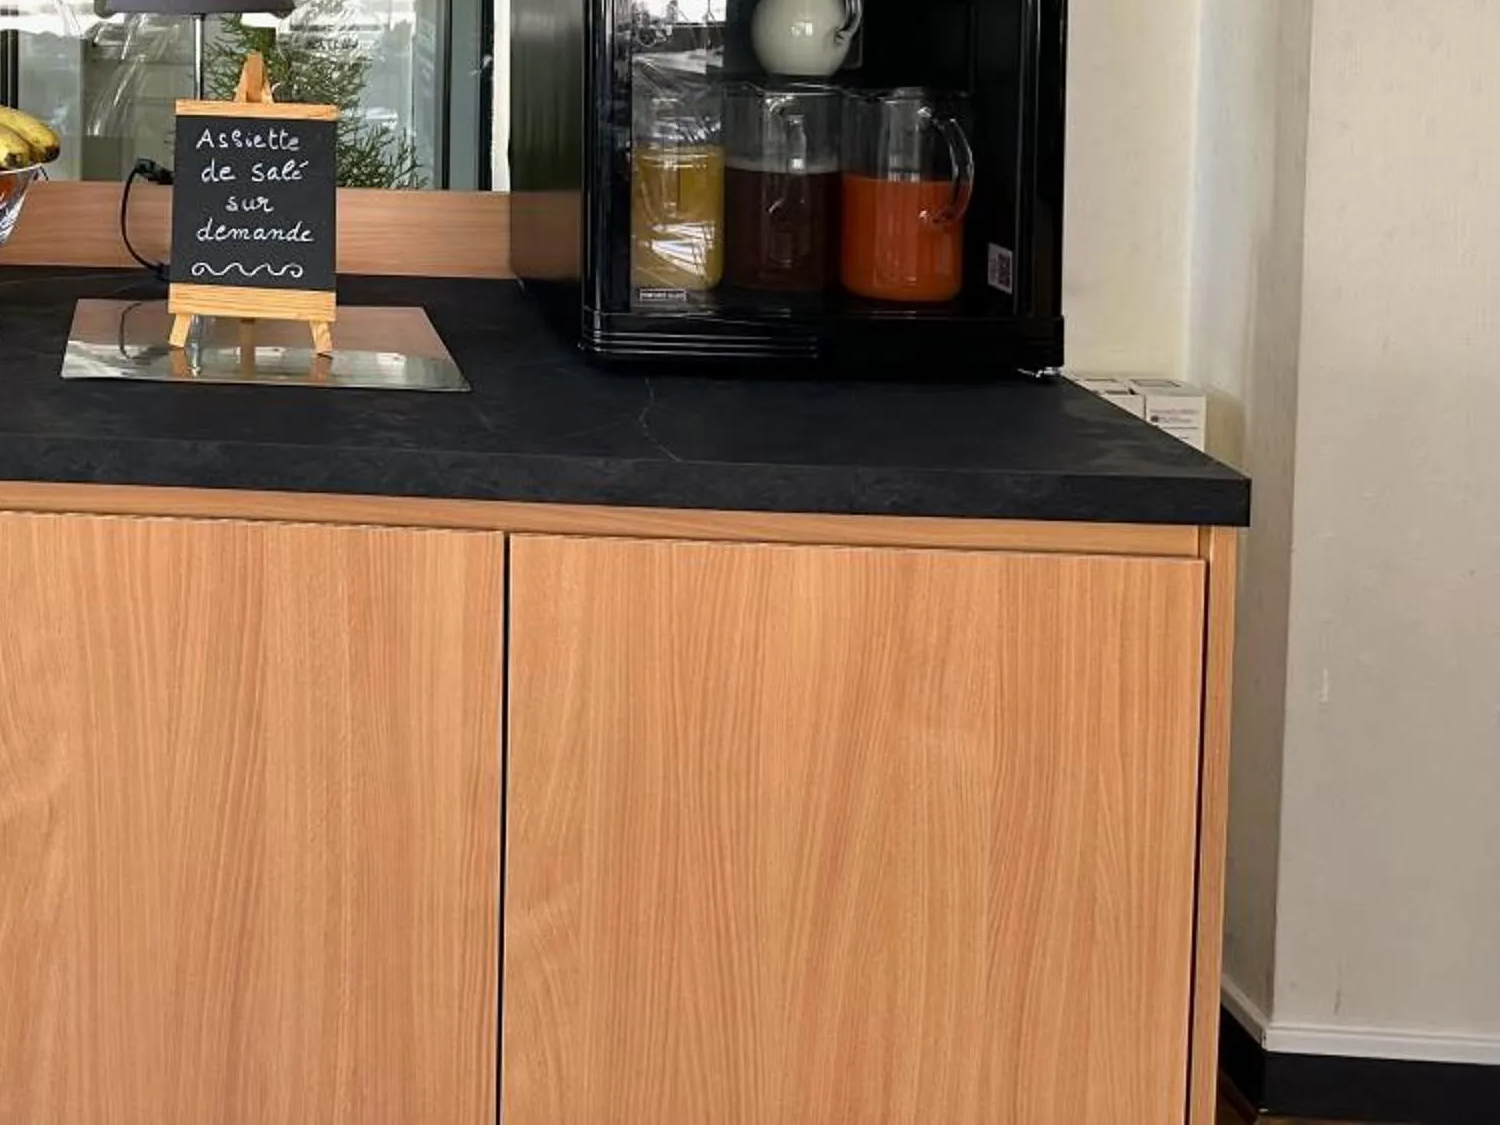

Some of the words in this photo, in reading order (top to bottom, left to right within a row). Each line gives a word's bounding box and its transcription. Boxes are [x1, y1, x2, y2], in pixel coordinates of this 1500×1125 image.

[196, 128, 300, 152] Assiette
[201, 159, 236, 183] de
[225, 195, 274, 213] sur
[196, 217, 315, 242] demande
